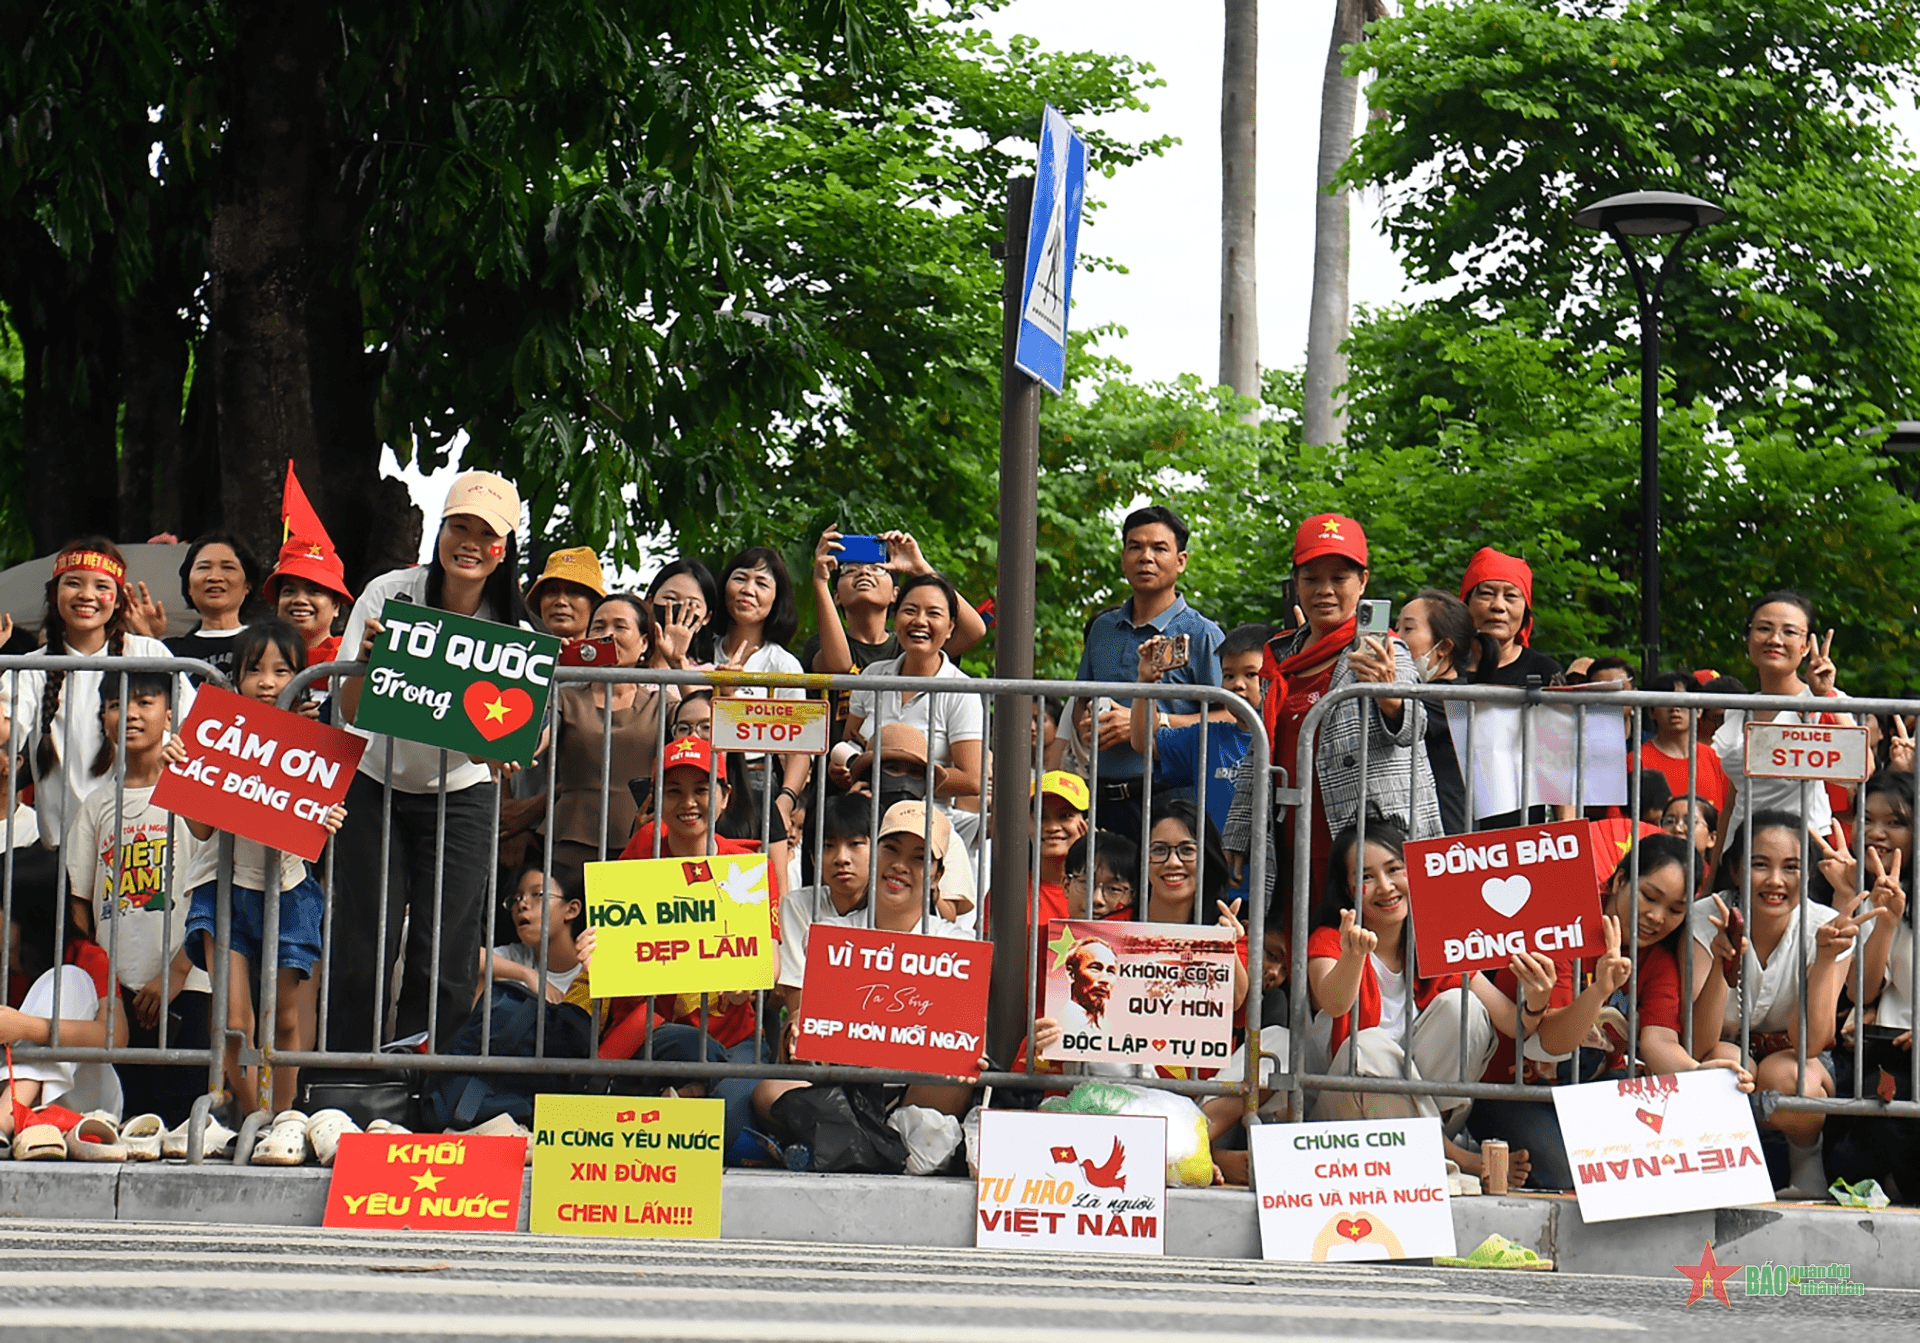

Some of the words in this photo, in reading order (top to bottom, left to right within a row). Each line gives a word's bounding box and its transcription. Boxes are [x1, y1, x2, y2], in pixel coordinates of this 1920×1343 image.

[385, 618, 444, 659] TỔ
[445, 634, 555, 687] QUỐC
[370, 666, 453, 721] Trong
[745, 704, 794, 716] POLICE
[736, 722, 803, 742] STOP
[1782, 730, 1832, 743] POLICE
[196, 714, 278, 768] CẢM
[280, 748, 341, 790] ƠN
[1772, 748, 1841, 769] STOP
[221, 771, 291, 811] ĐỒNG
[1425, 841, 1509, 877] ĐỒNG
[1516, 831, 1579, 865] BÀO
[588, 899, 647, 927] HÒA
[656, 895, 716, 924] BÌNH
[634, 940, 690, 966] ĐẸP
[698, 919, 758, 959] LẮM
[1444, 928, 1527, 963] ĐỒNG
[1534, 916, 1584, 951] CHÍ
[827, 940, 855, 967] VÌ
[860, 943, 895, 971] TỔ
[900, 952, 971, 979] QUỐC
[1119, 962, 1179, 980] KHÔNG
[1184, 965, 1208, 981] CÓ
[1213, 964, 1231, 982] GÌ
[855, 983, 890, 1011] Ta
[885, 986, 934, 1016] Sống
[1129, 994, 1173, 1015] QUÝ
[1180, 1000, 1223, 1018] HƠN
[802, 1018, 844, 1039] ĐẸP
[848, 1021, 886, 1041] HƠN
[890, 1024, 928, 1046] MỖI
[929, 1029, 981, 1052] NGÀY
[1062, 1031, 1102, 1054] ĐỘC
[1107, 1034, 1148, 1055] LẬP
[1169, 1039, 1196, 1060] TỰ
[1201, 1041, 1228, 1057] DO
[386, 1138, 466, 1165] KHỐI
[535, 1130, 555, 1146] AI
[561, 1127, 614, 1148] CŨNG
[621, 1129, 661, 1149] YÊU
[667, 1130, 720, 1150] NƯỚC
[1293, 1129, 1359, 1150] CHÚNG
[1366, 1131, 1406, 1147] CON
[570, 1162, 607, 1182] XIN
[614, 1158, 677, 1184] ĐỪNG
[1314, 1157, 1358, 1179] CẢM
[1364, 1160, 1391, 1177] ƠN
[1577, 1155, 1662, 1185] NAM
[342, 1192, 411, 1216] YÊU
[418, 1192, 510, 1219] NƯỚC
[979, 1172, 1016, 1208] TỰ
[1019, 1172, 1075, 1205] HÀO
[1106, 1194, 1155, 1216] người
[1262, 1189, 1313, 1209] ĐẢNG
[1319, 1188, 1343, 1206] VÀ
[1349, 1186, 1387, 1206] NHÀ
[1393, 1183, 1444, 1203] NƯỚC
[557, 1203, 617, 1223] CHEN
[624, 1200, 693, 1226] LẤN!!!
[1077, 1213, 1157, 1239] NAM
